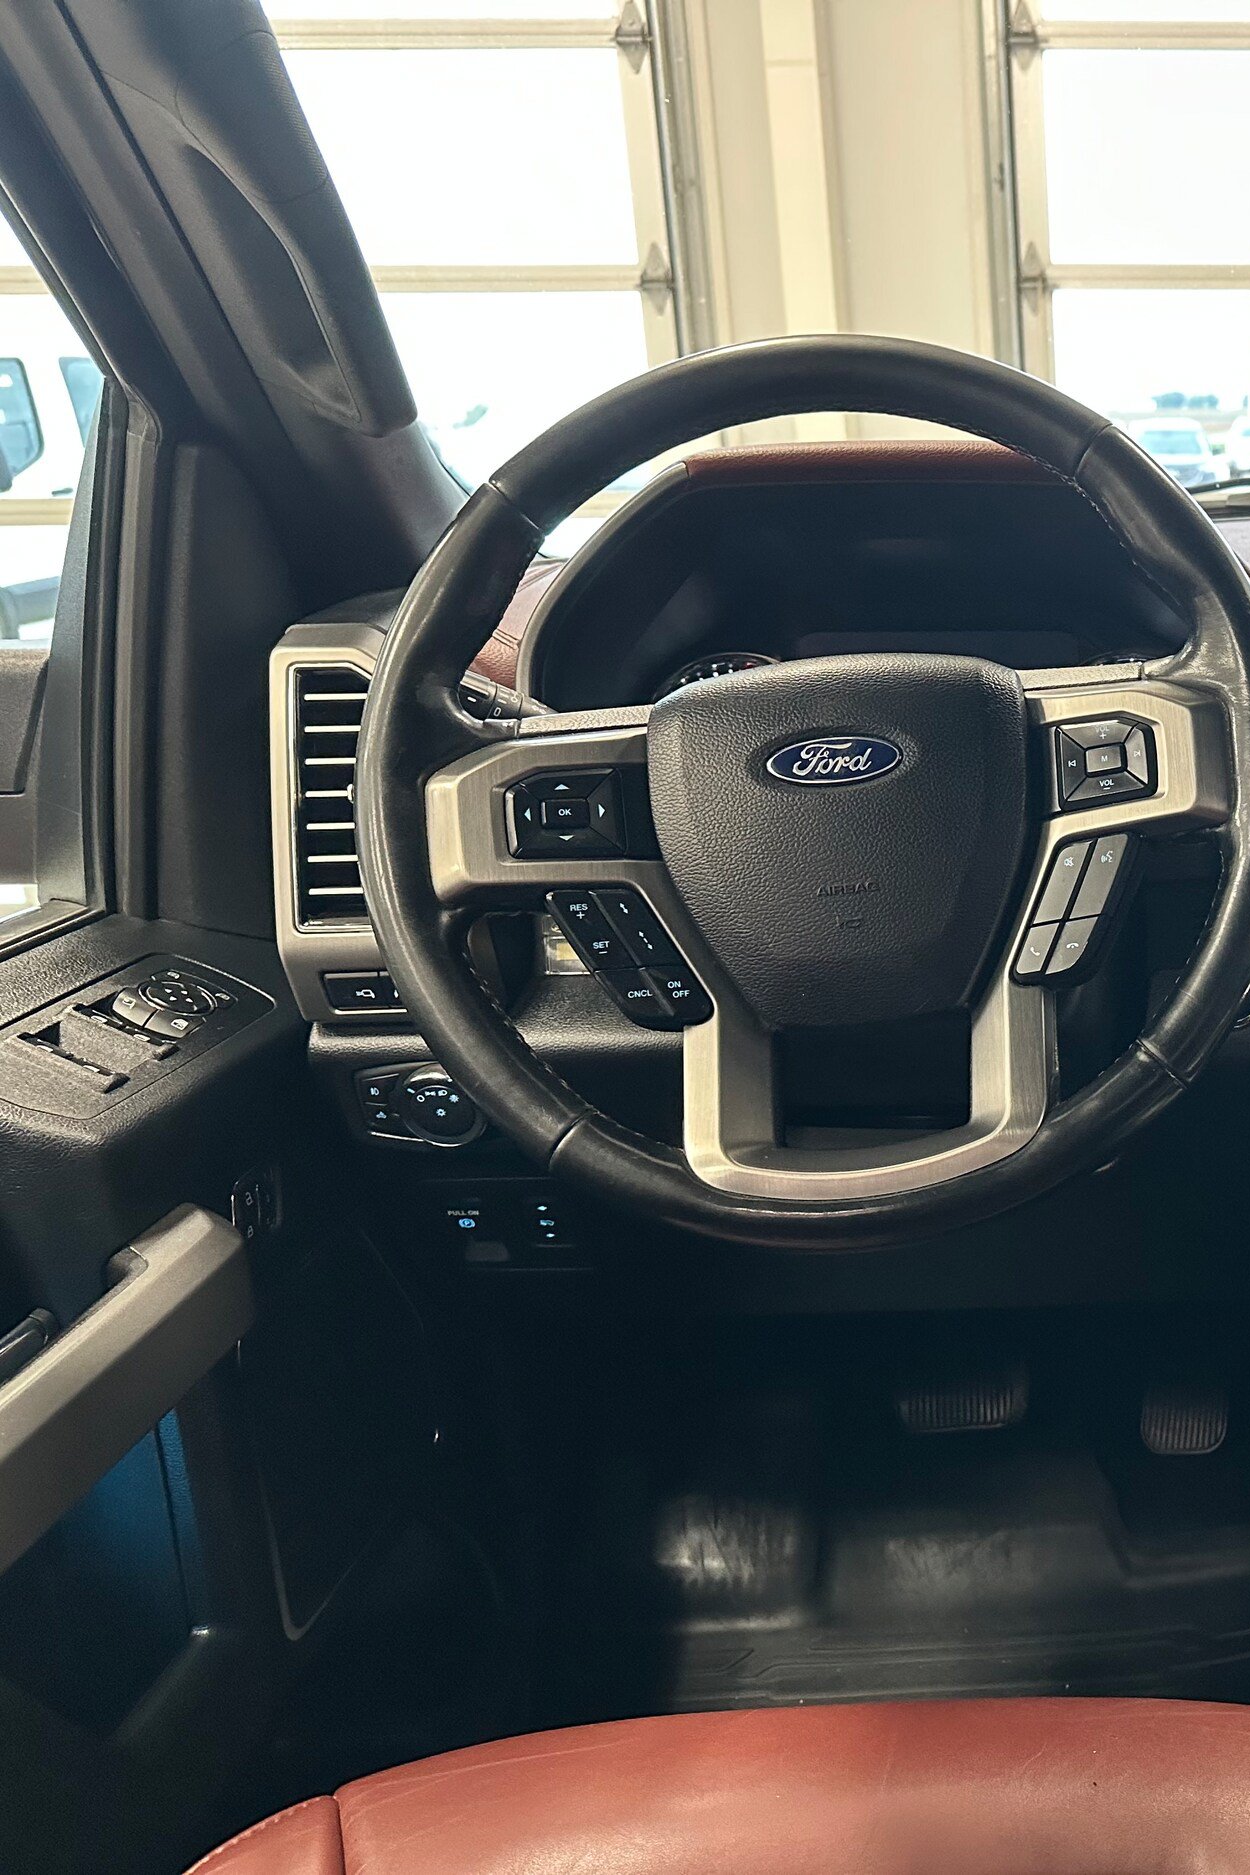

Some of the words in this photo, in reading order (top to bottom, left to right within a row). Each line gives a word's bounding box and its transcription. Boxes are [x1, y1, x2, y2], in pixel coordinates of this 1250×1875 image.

[1095, 725, 1110, 733] VOL
[792, 742, 873, 776] Ford
[1099, 779, 1114, 787] VOL
[558, 808, 572, 816] OK
[817, 881, 880, 897] AIRBAG
[569, 903, 589, 912] RES
[592, 940, 610, 949] SET
[667, 981, 681, 989] ON
[627, 989, 653, 999] CNCL
[672, 989, 690, 999] OFF
